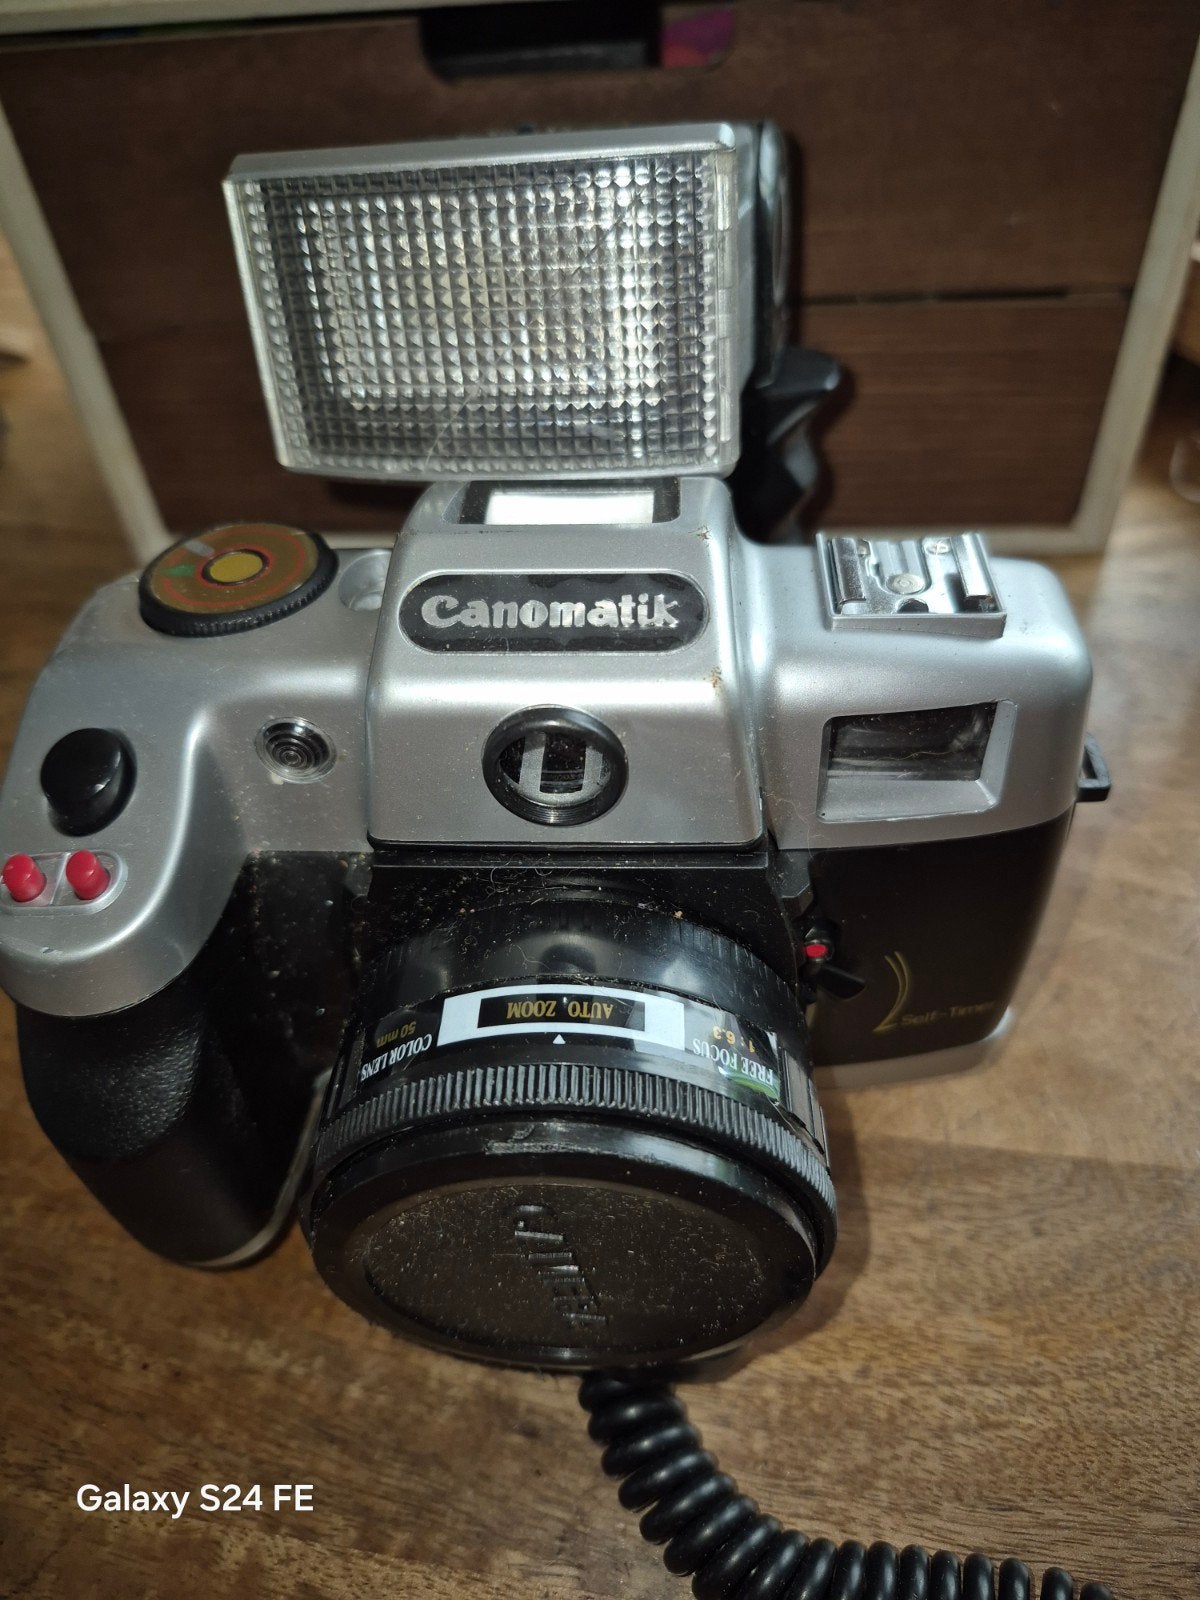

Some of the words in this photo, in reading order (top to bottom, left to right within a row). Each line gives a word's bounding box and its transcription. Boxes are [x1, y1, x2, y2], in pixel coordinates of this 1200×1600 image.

[421, 593, 679, 629] Canomatik
[506, 1000, 556, 1020] ZOOM
[567, 1000, 615, 1020] AUTO
[400, 1020, 417, 1039] 50
[360, 1053, 388, 1082] LENS
[388, 1033, 433, 1072] COLOR
[692, 1037, 738, 1071] FOCUS
[741, 1053, 774, 1086] FREE
